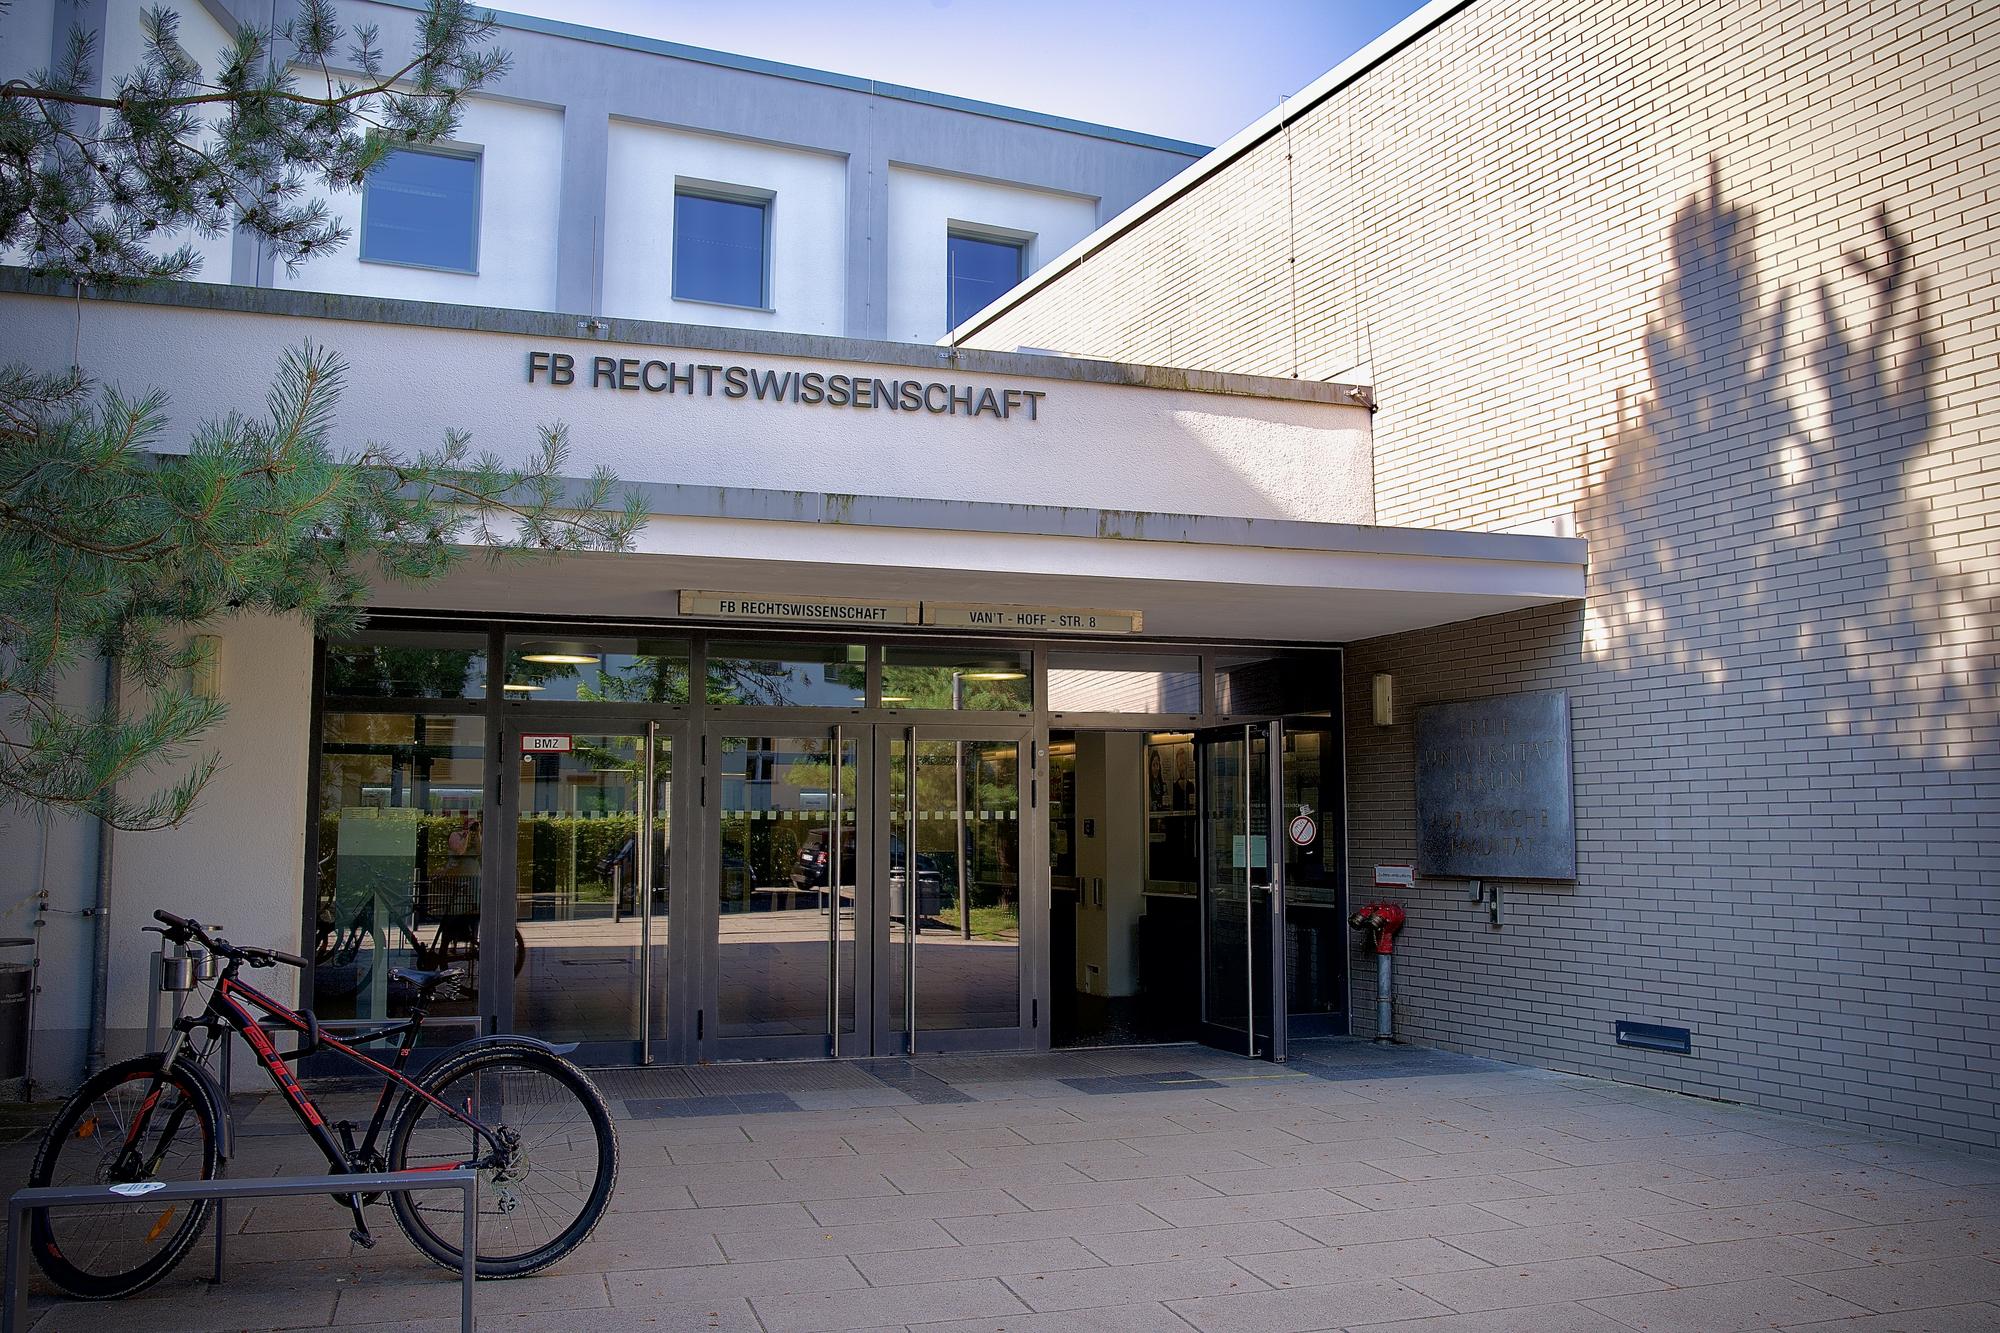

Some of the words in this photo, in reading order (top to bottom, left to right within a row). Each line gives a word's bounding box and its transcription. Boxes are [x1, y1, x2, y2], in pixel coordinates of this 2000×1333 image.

[529, 351, 575, 385] FB
[593, 356, 1046, 421] RECHTSWISSENSCHAFT
[720, 601, 735, 613] FB
[741, 601, 887, 620] RECHTSWISSENSCHAFT
[1017, 613, 1046, 626] HOFF
[1060, 615, 1085, 628] STR.
[1089, 616, 1096, 628] 8
[534, 738, 559, 748] BMZ
